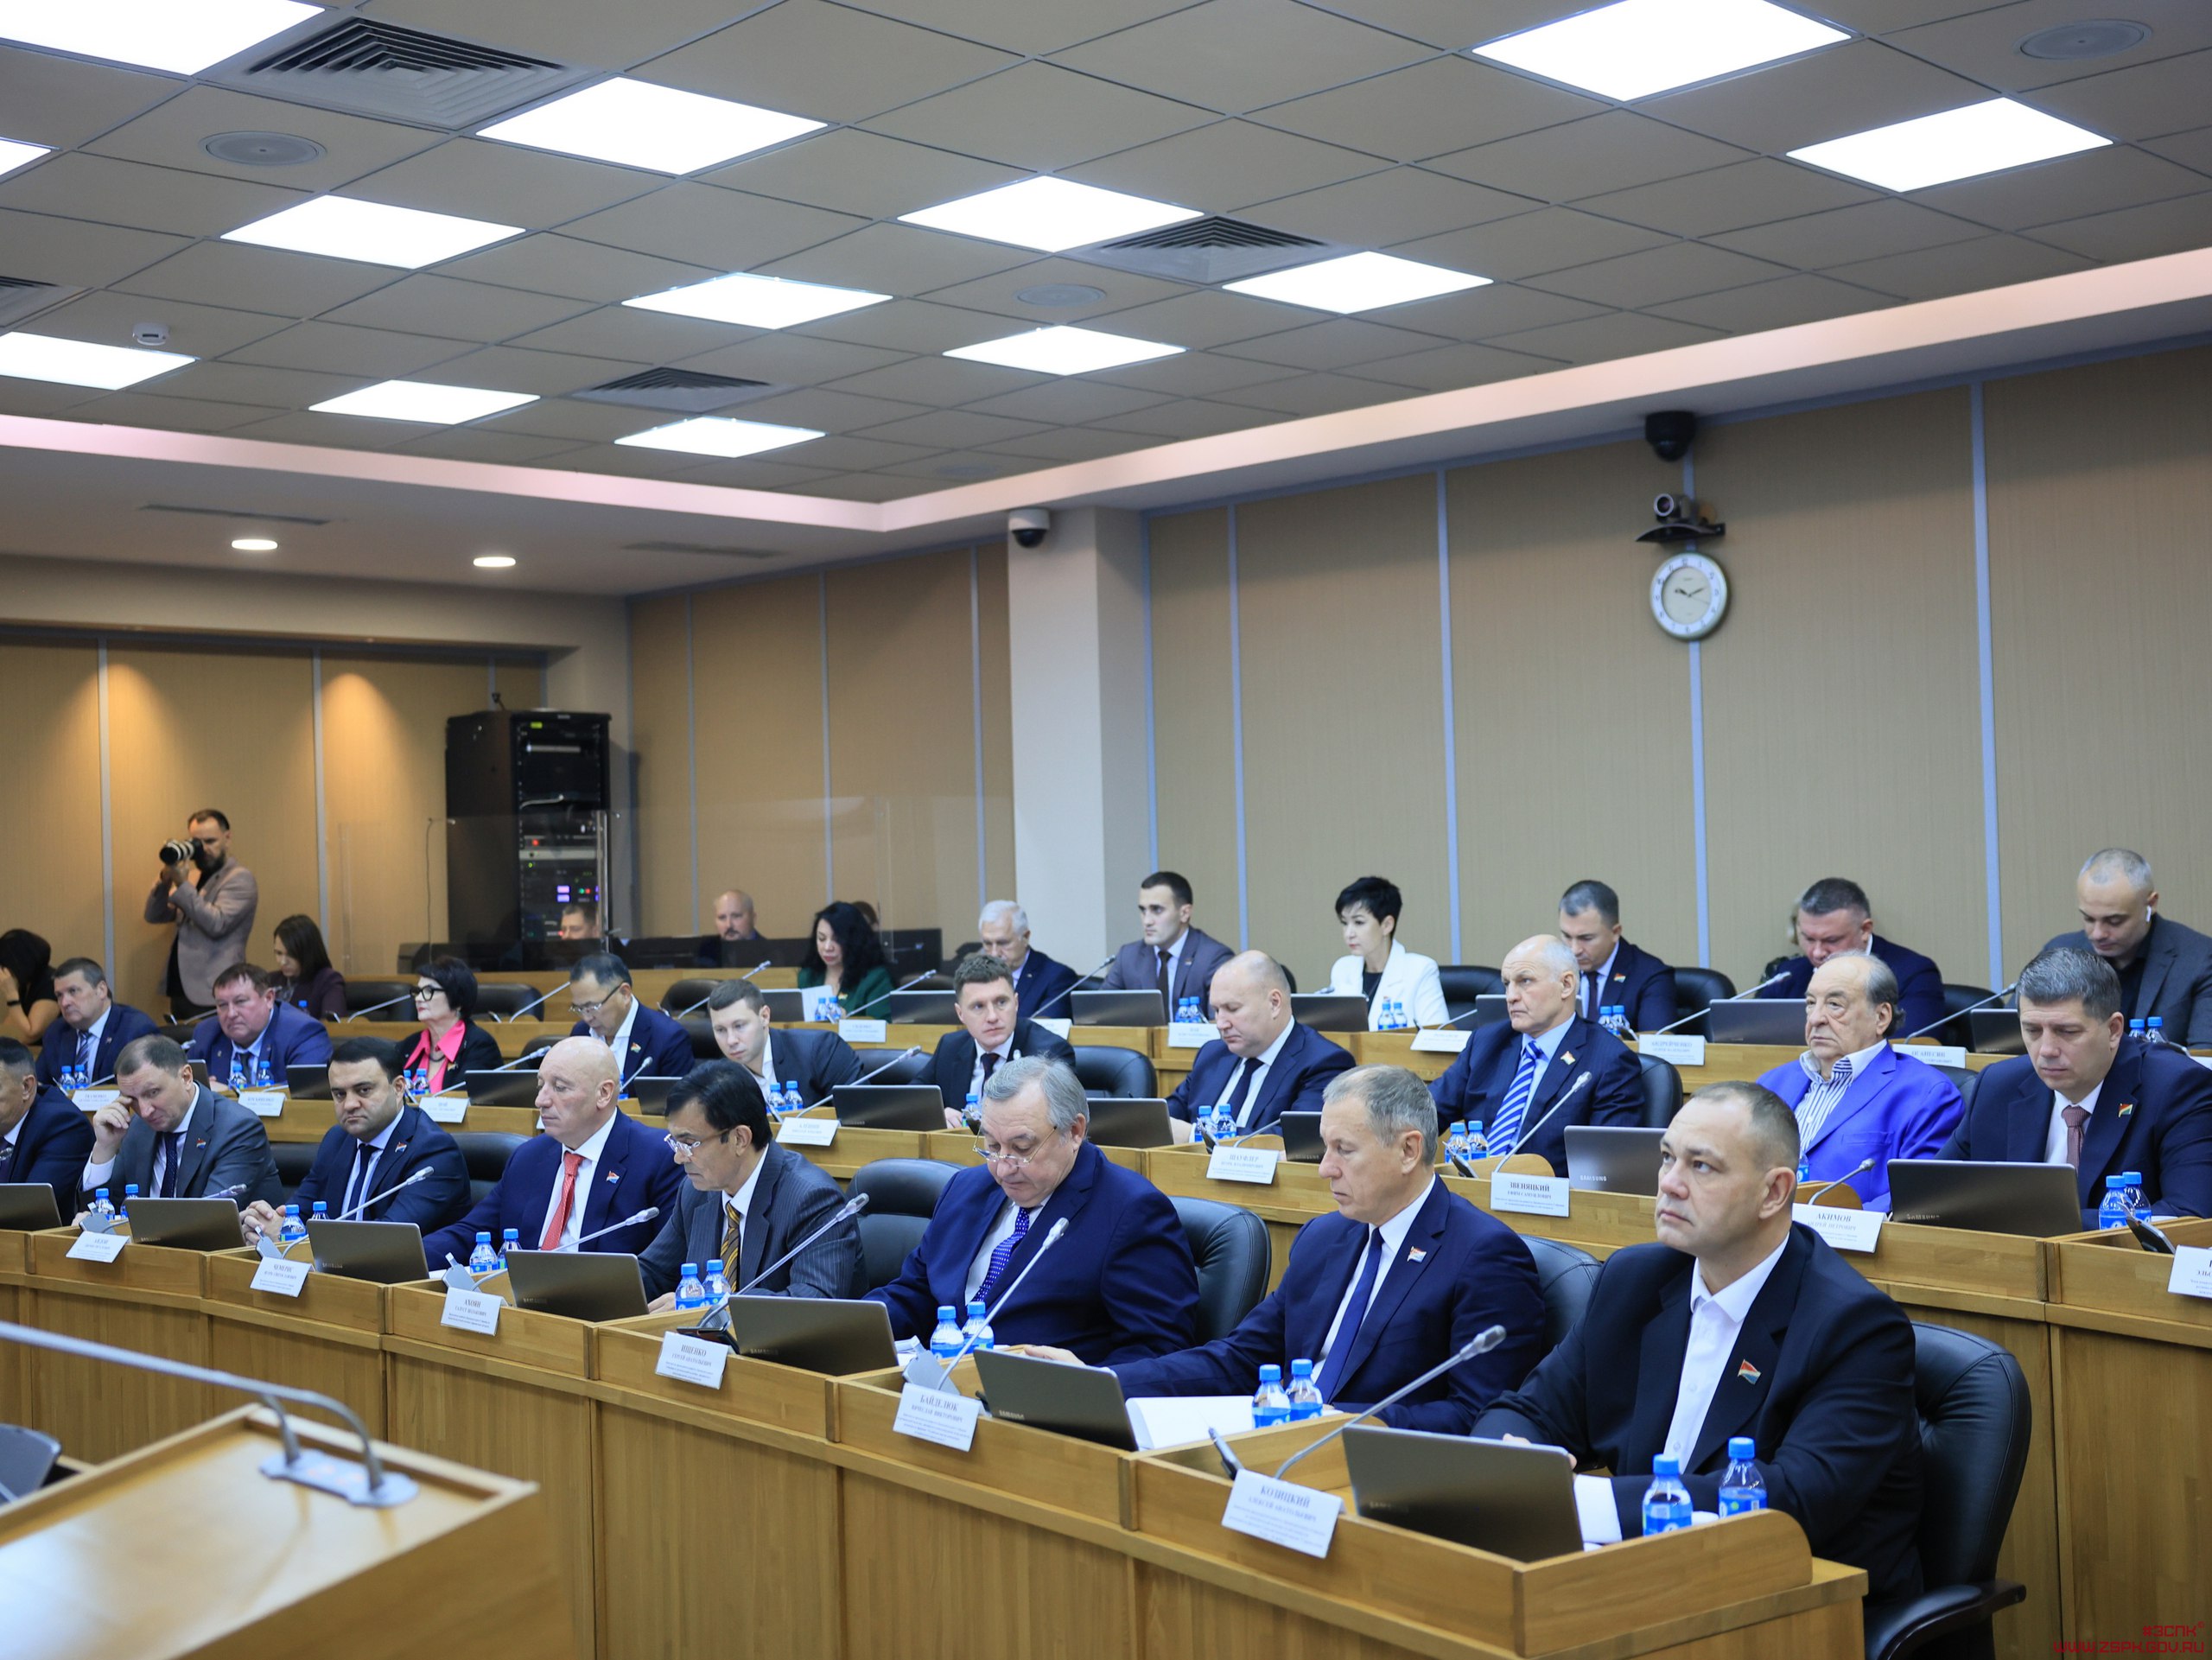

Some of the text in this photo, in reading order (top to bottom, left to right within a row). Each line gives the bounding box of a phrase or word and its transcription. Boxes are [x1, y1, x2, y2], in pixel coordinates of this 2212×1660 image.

[1510, 1181, 1550, 1192] ЗВЕНЯЦКИЙ
[1817, 1212, 1852, 1222] АКИМОВ
[681, 1345, 707, 1357] ИЩЕНКО
[919, 1395, 958, 1411] БАЙДЕЛЮК
[1261, 1485, 1311, 1508] КОЗИЦКИЙ
